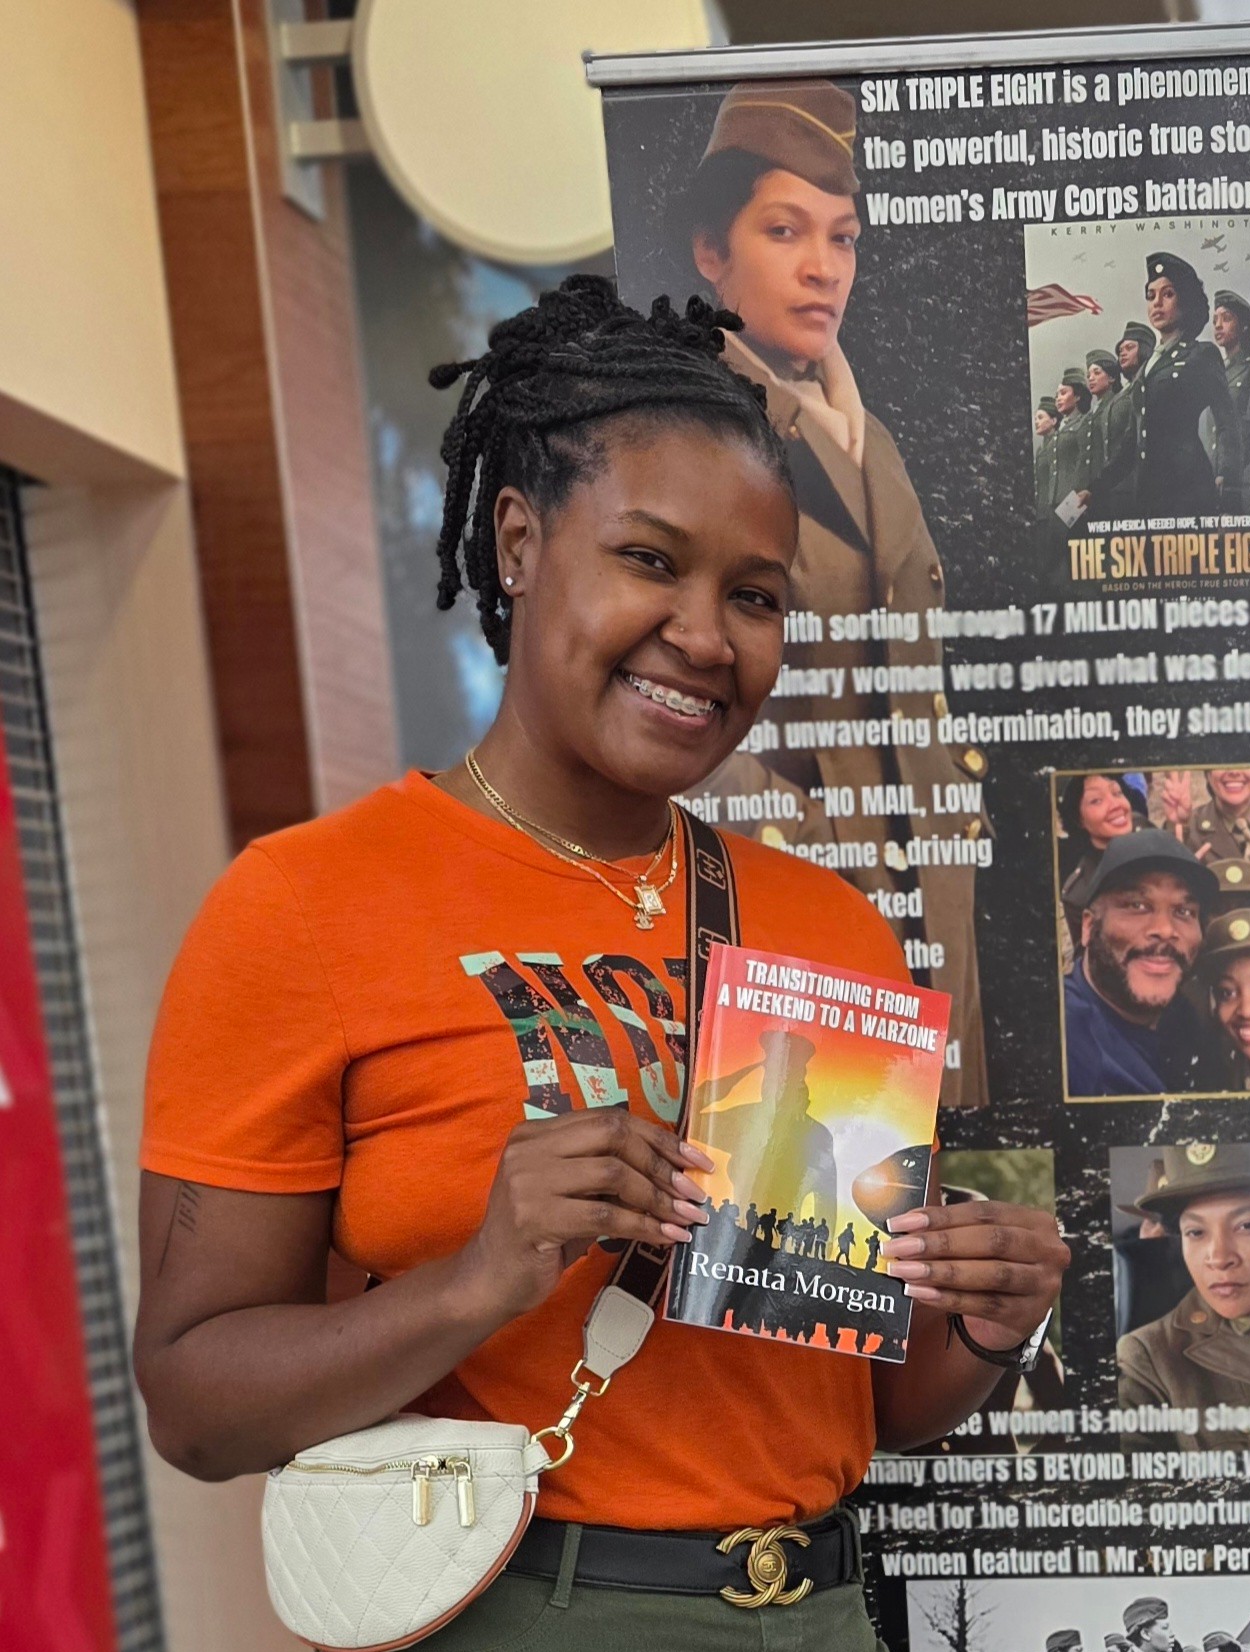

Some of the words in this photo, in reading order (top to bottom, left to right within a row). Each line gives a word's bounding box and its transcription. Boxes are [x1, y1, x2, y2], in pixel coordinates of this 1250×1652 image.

[861, 78, 899, 112] SIX
[907, 74, 983, 110] TRIPLE
[991, 72, 1057, 108] EIGHT
[1063, 69, 1086, 103] is
[1094, 76, 1110, 102] a
[864, 135, 907, 170] the
[914, 130, 1035, 172] powerful,
[1042, 124, 1143, 163] historic
[1151, 123, 1203, 156] true
[866, 188, 985, 226] Women’s
[991, 187, 1057, 222] Army
[1063, 185, 1139, 219] Corps
[1051, 224, 1116, 236] KERRY
[1088, 521, 1111, 533] WHEN
[1112, 519, 1146, 532] AMERICA
[1148, 518, 1175, 531] NEEDED
[1177, 517, 1198, 530] HOPE,
[1200, 516, 1219, 529] THEY
[1068, 538, 1106, 580] THE
[1110, 536, 1147, 579] SIX
[1151, 533, 1220, 577] TRIPLE
[1102, 582, 1130, 592] BASED
[1132, 581, 1145, 591] ON
[1147, 580, 1162, 591] THE
[1164, 580, 1197, 590] HEROIC
[1199, 579, 1221, 589] TRUE
[1223, 578, 1250, 588] STORY
[829, 607, 919, 642] sorting
[1031, 603, 1056, 634] 17
[1065, 598, 1157, 634] MILLION
[1164, 596, 1248, 634] pieces
[852, 665, 942, 693] women
[951, 661, 1013, 690] were
[1020, 657, 1088, 692] given
[1096, 653, 1157, 683] what
[1166, 653, 1216, 682] was
[785, 714, 930, 748] unwavering
[938, 707, 1119, 745] determination,
[1127, 703, 1179, 738] they
[727, 789, 804, 821] motto,
[862, 785, 926, 817] MAIL,
[933, 783, 982, 813] LOW
[908, 835, 992, 868] driving
[904, 939, 944, 968] the
[746, 960, 871, 1008] TRANSITIONING
[875, 988, 920, 1020] FROM
[717, 983, 730, 1007] A
[736, 986, 815, 1023] WEEKEND
[820, 1003, 842, 1028] TO
[843, 1009, 855, 1032] A
[861, 1012, 938, 1052] WARZONE
[689, 1250, 786, 1293] Renata
[793, 1272, 896, 1315] Morgan
[989, 1409, 1074, 1434] women
[1081, 1404, 1101, 1433] is
[1110, 1403, 1198, 1434] nothing
[933, 1456, 1010, 1483] others
[1016, 1456, 1037, 1481] is
[1045, 1453, 1125, 1481] BEYOND
[941, 1503, 974, 1529] for
[981, 1502, 1019, 1529] the
[1026, 1500, 1142, 1528] incredible
[882, 1552, 967, 1576] women
[974, 1549, 1071, 1575] featured
[1078, 1547, 1099, 1572] in
[1106, 1546, 1144, 1573] Mr.
[1150, 1545, 1206, 1575] Tyler
